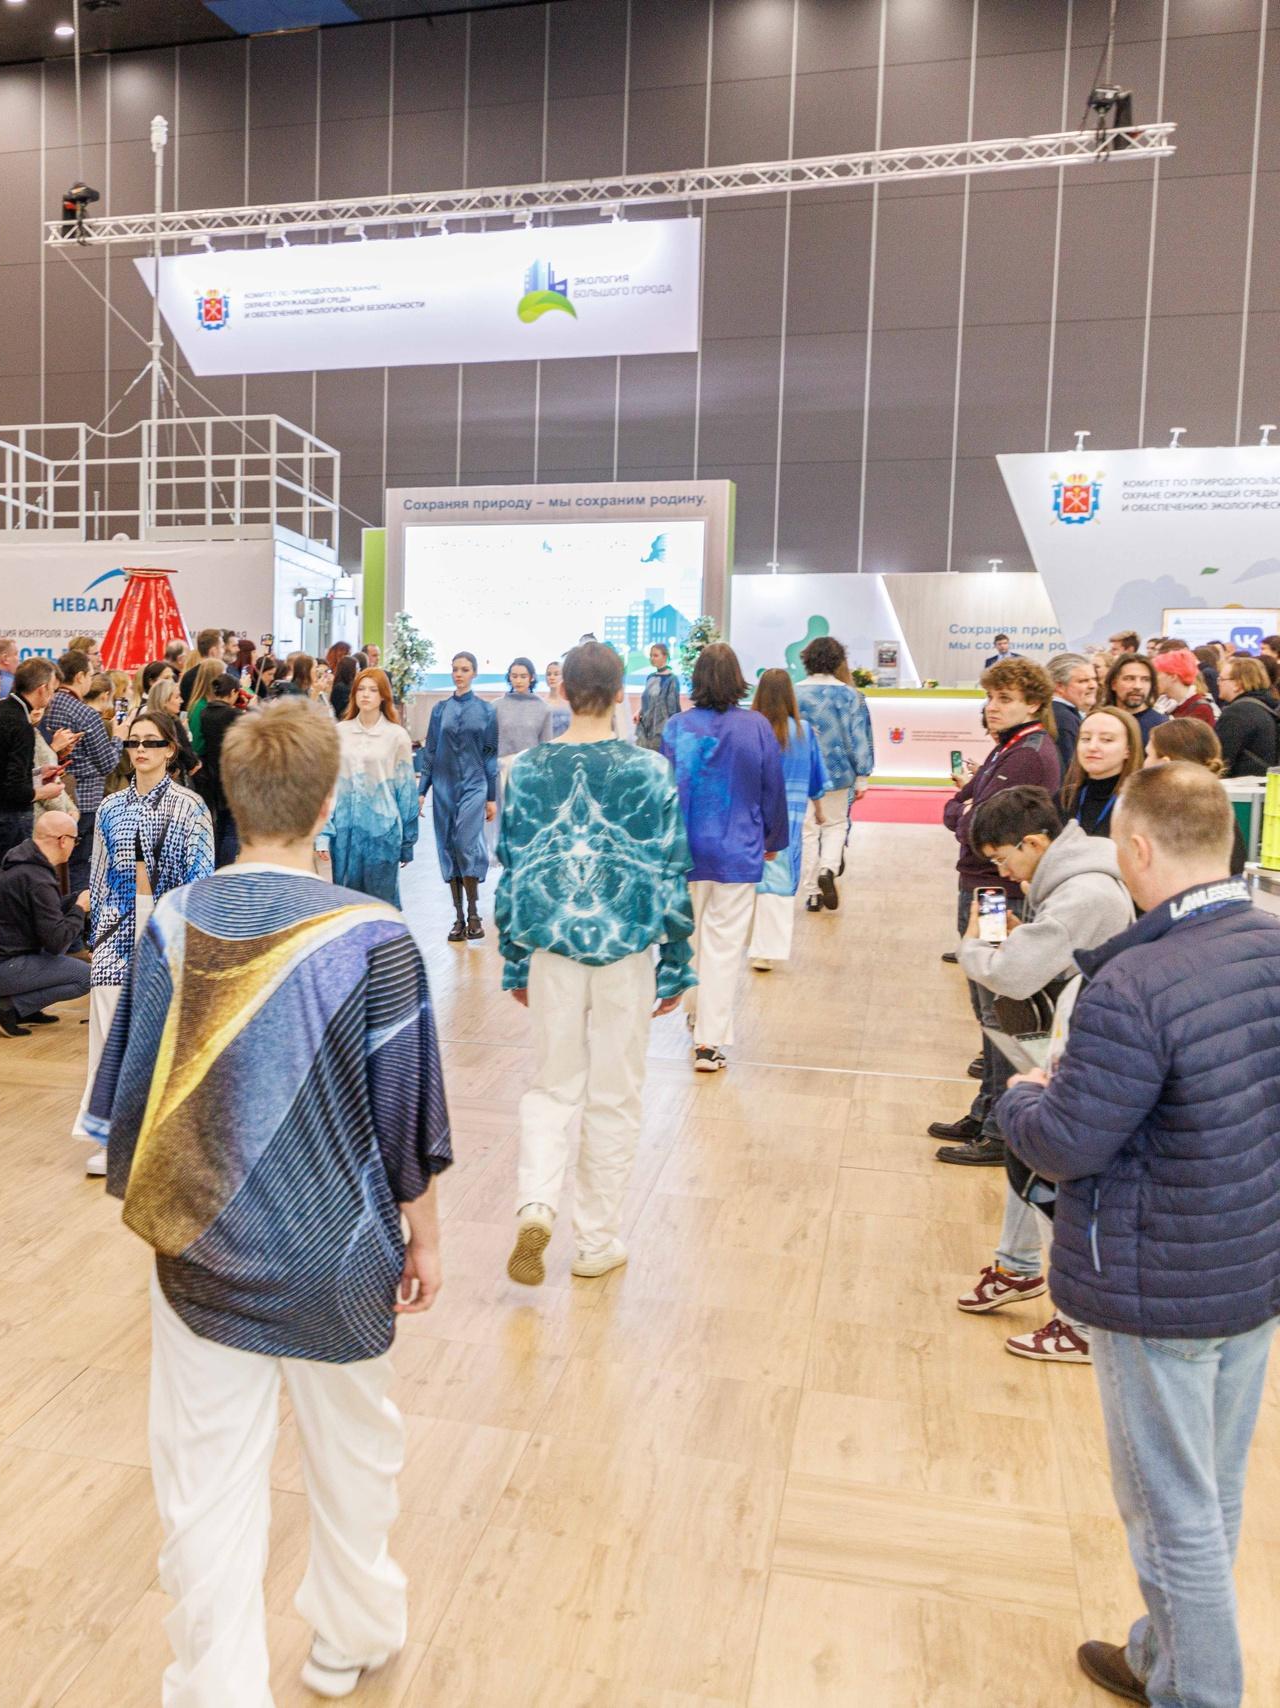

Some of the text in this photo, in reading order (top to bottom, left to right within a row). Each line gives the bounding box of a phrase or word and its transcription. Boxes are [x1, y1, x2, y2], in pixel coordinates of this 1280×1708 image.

[574, 274, 629, 285] ЭКОЛОГИЯ
[574, 284, 673, 298] БОЛЬШОГО ГОРОДА
[367, 301, 425, 311] БЕЗОПАСНОСТИ
[1122, 479, 1170, 488] КОМИТЕТ
[1173, 478, 1188, 487] ПО
[1122, 489, 1278, 500] ОХРАНЕ ОКРУЖАЮЩЕЙ СРЕДЫ
[403, 499, 469, 512] Сохраняя
[473, 499, 533, 511] природу
[548, 498, 571, 507] мы
[575, 496, 646, 509] сохраним
[650, 495, 707, 507] родину.
[1122, 504, 1129, 512] И
[1131, 502, 1208, 512] ОБЕСПЕЧЕНИЮ
[19, 629, 61, 638] КОНТРОЛЯ
[949, 624, 1017, 635] Сохраняя
[949, 642, 971, 650] мы
